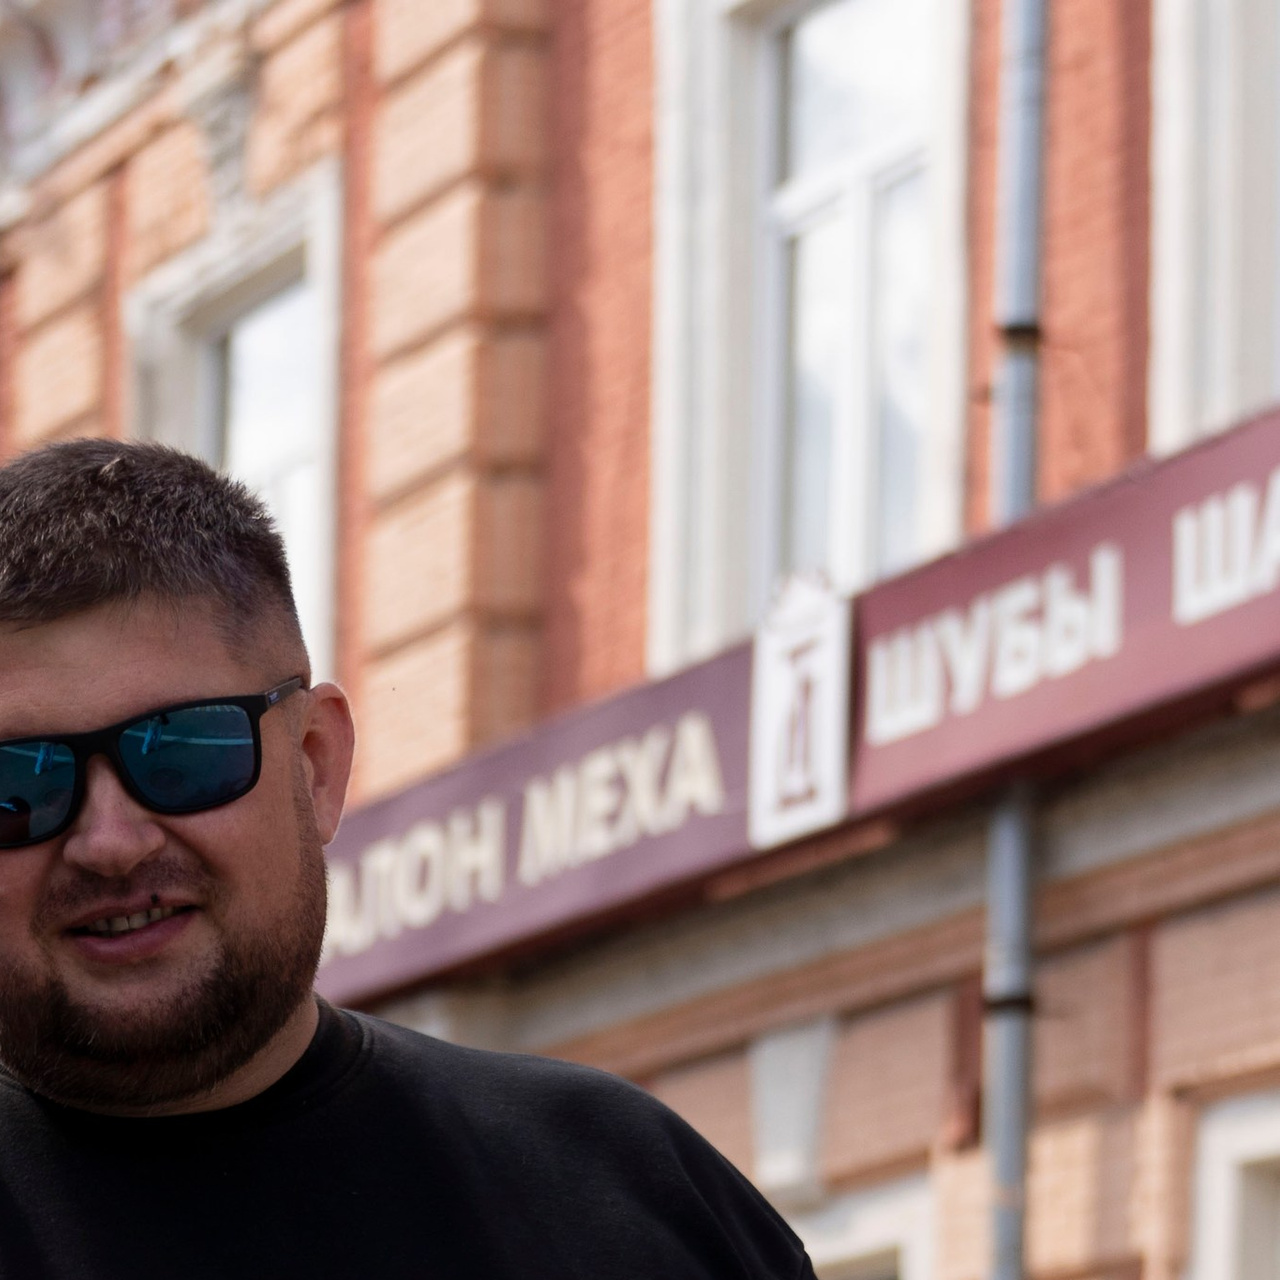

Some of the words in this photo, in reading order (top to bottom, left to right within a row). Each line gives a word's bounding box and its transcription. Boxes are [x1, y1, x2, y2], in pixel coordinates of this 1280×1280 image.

[864, 543, 1123, 748] ШУБЫ
[318, 798, 506, 966] АЛОН
[519, 710, 723, 888] МЕХА
